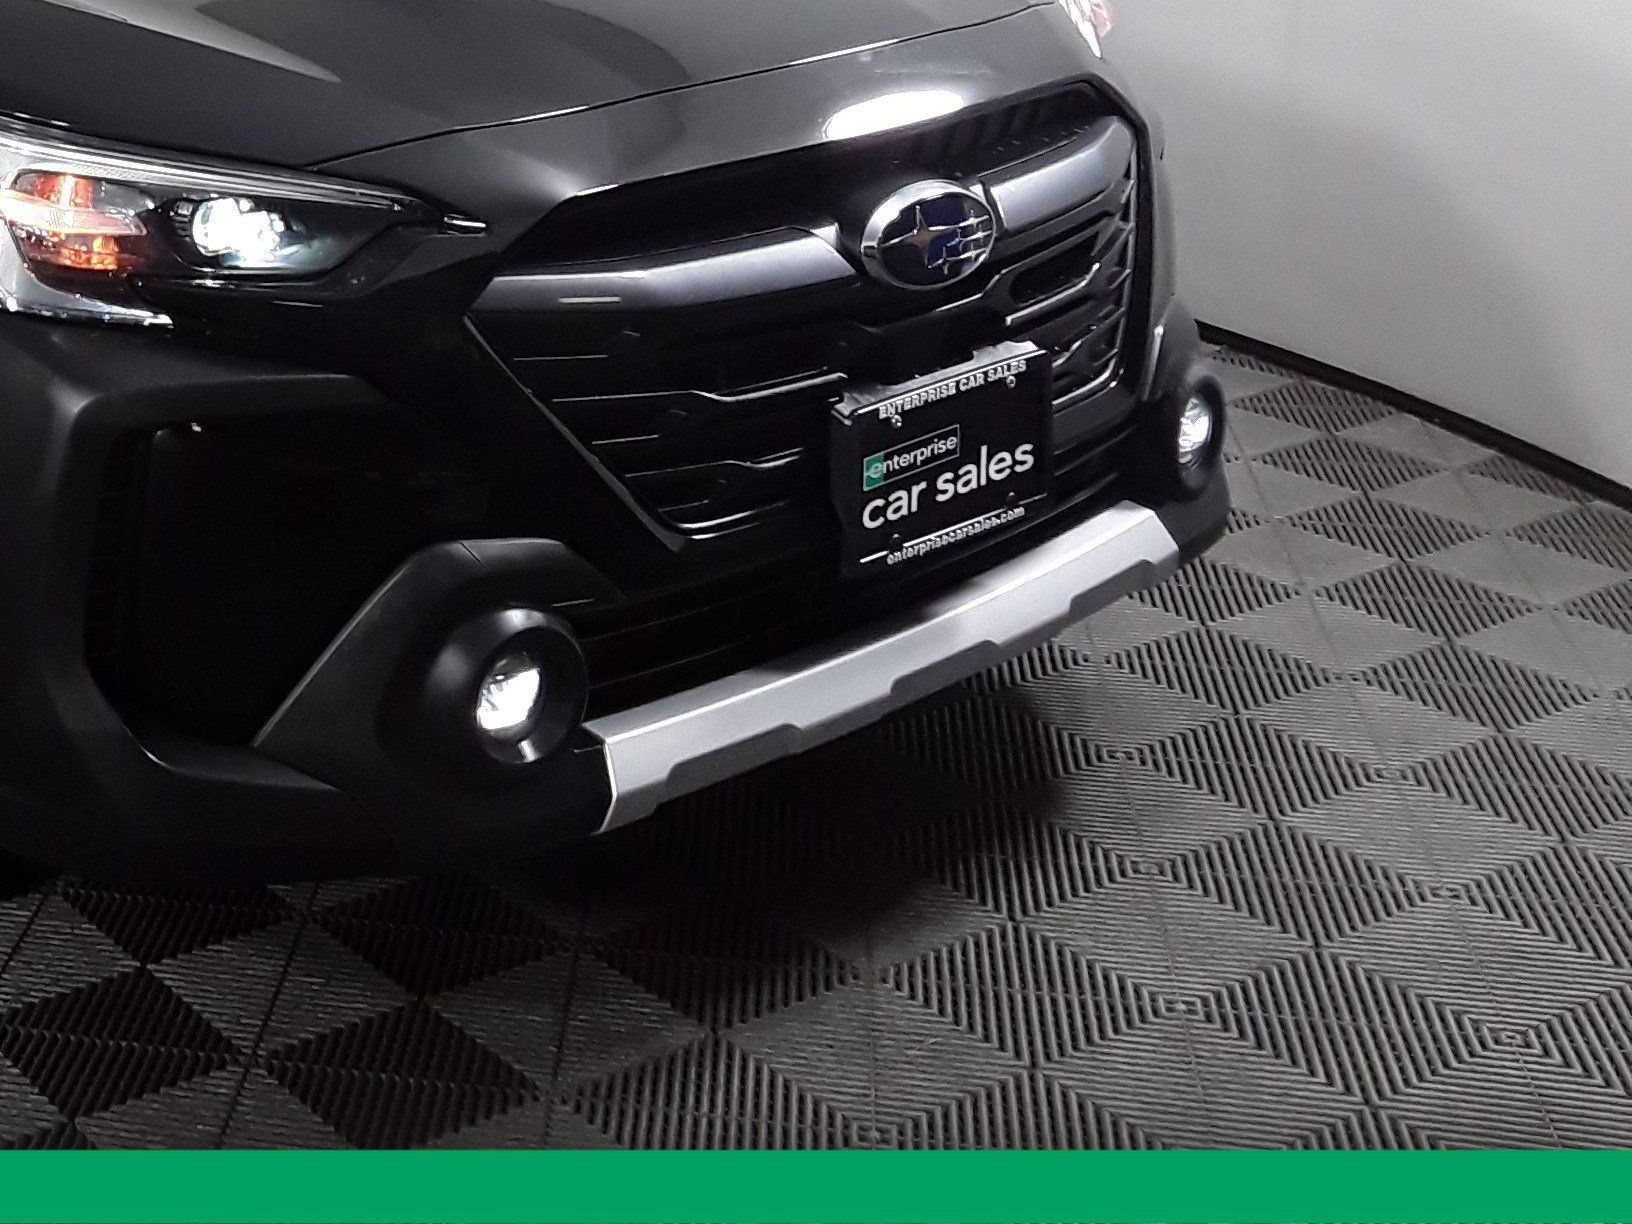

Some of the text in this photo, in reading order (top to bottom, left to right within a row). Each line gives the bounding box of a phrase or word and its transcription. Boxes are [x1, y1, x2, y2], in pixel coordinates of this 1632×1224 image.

[879, 360, 1027, 418] ENTERPRISE CAR SALES
[866, 435, 958, 478] enterprise
[862, 443, 1035, 529] car sales
